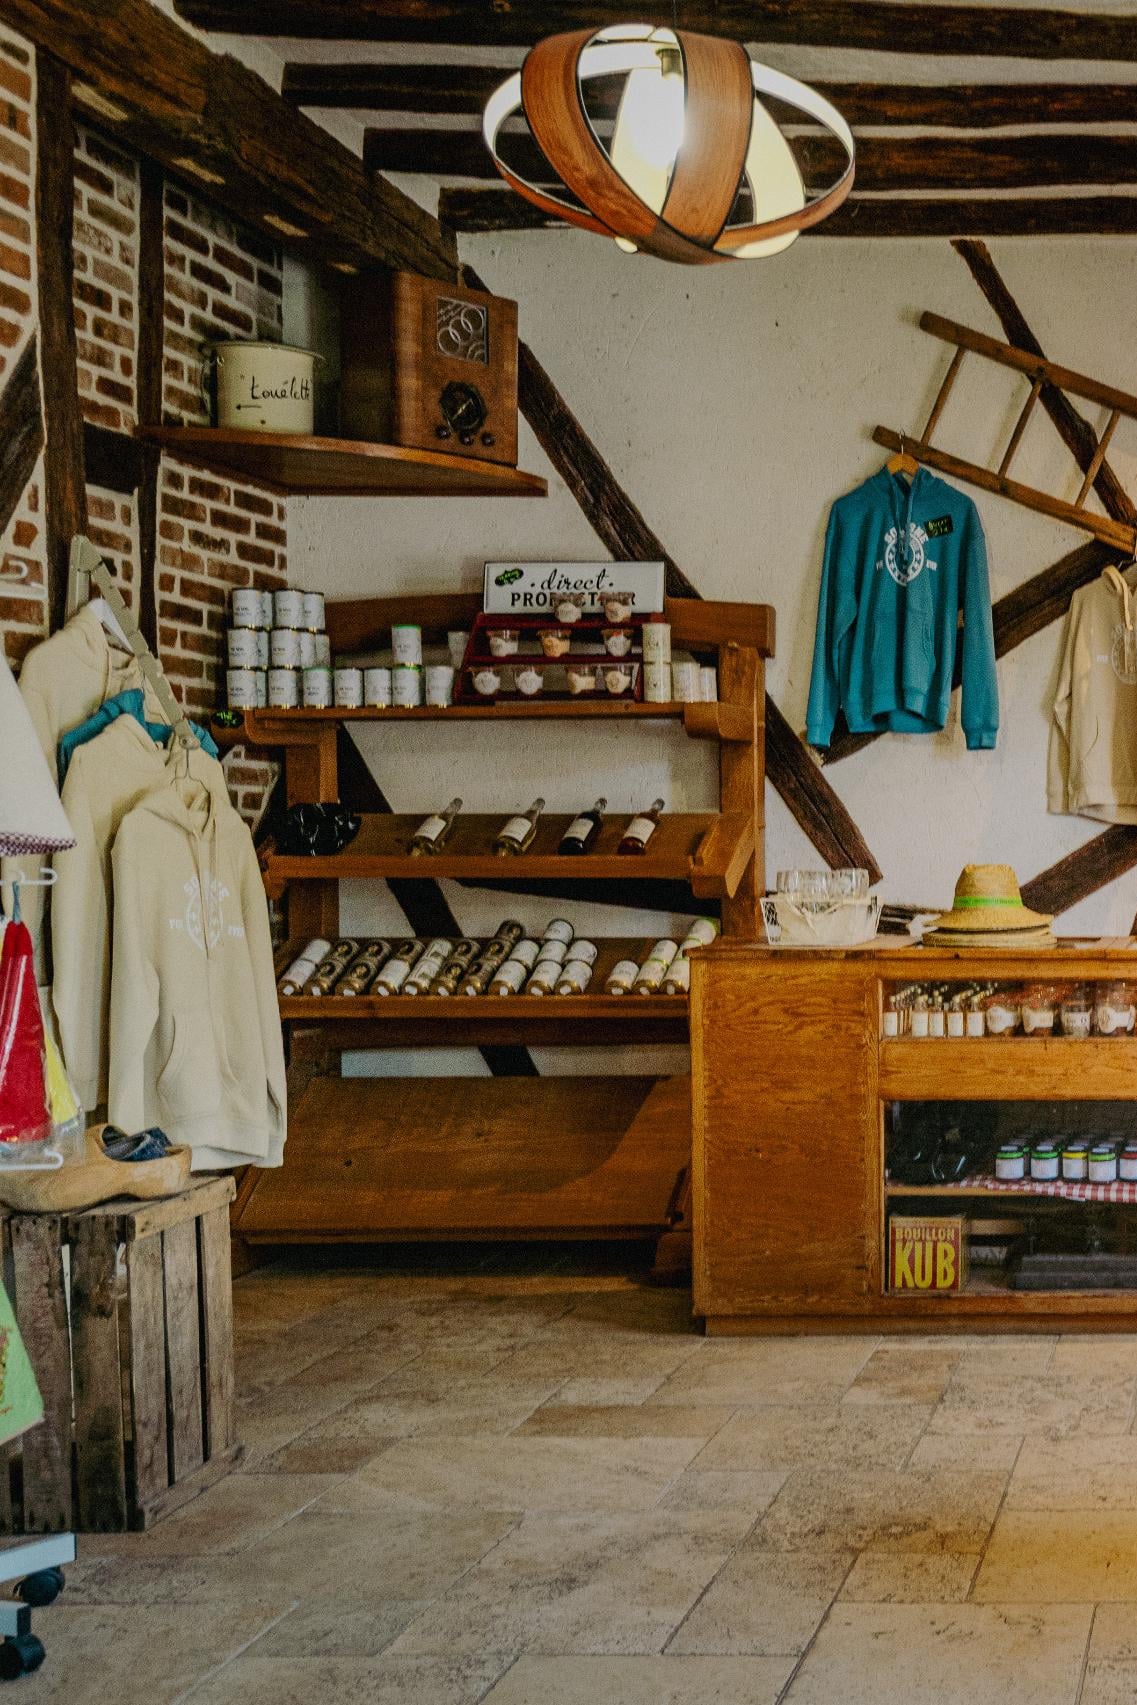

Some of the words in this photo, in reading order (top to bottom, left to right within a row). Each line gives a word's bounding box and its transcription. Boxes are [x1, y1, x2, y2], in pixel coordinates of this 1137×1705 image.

[540, 568, 608, 591] direct
[895, 1227, 955, 1240] BOUILLON
[895, 1240, 956, 1289] KUB
